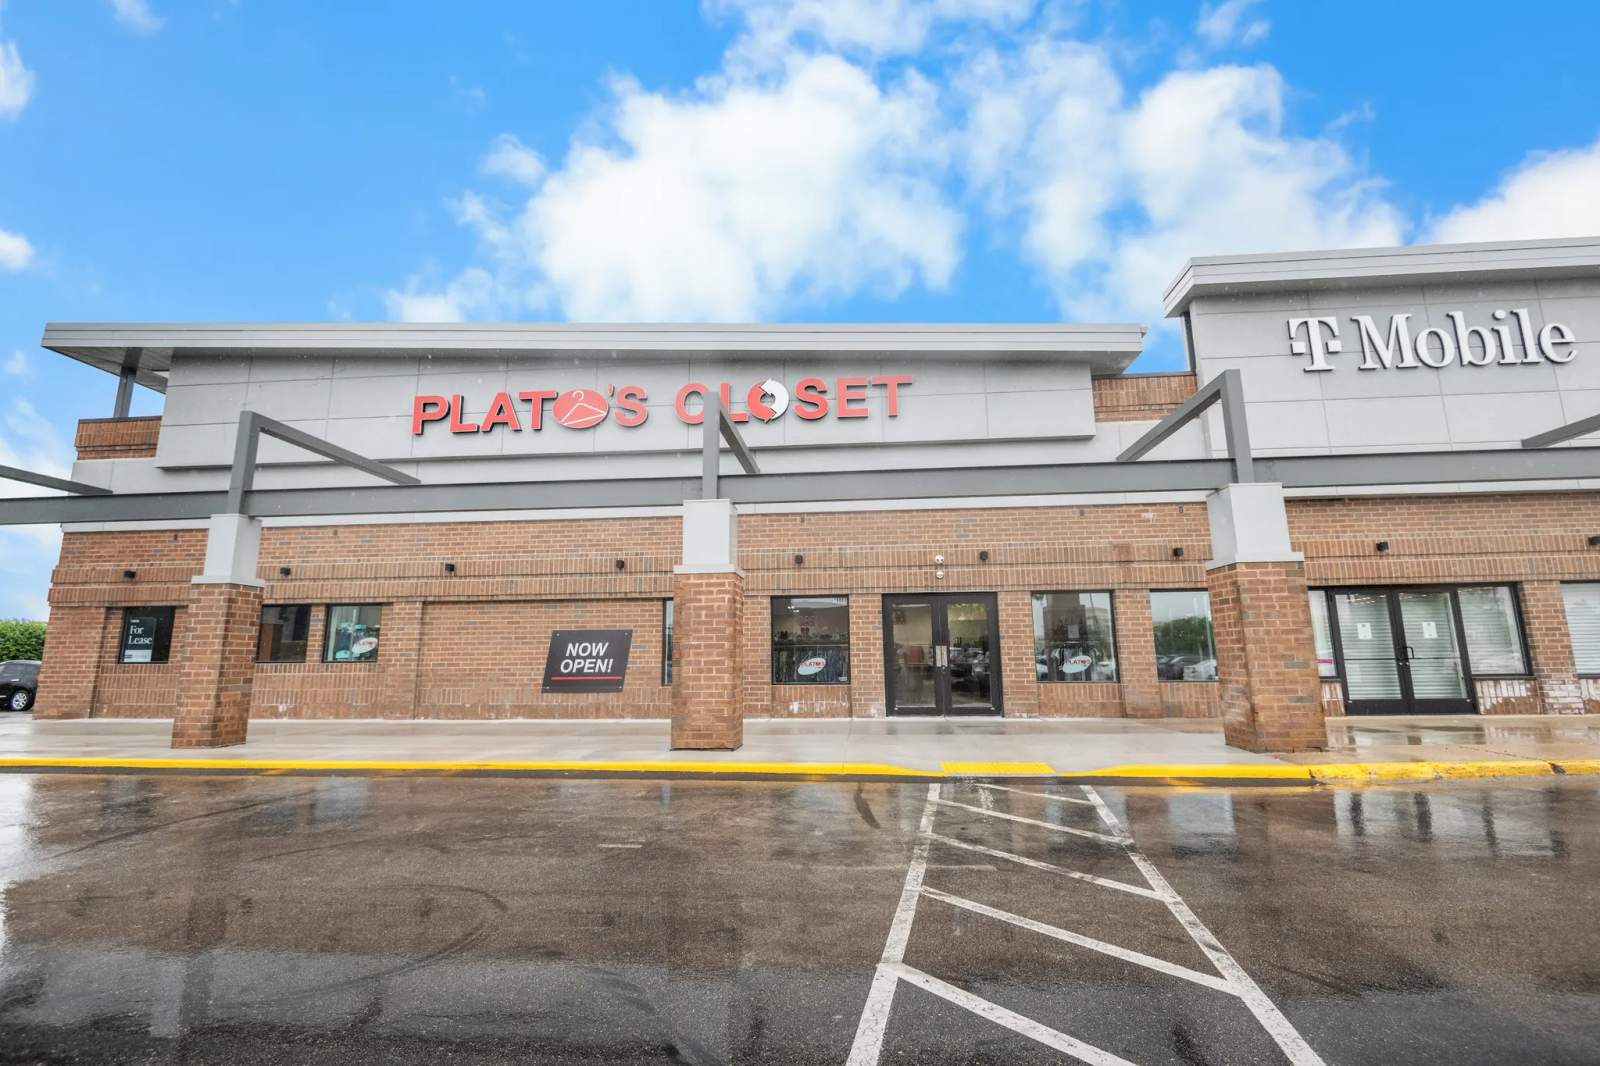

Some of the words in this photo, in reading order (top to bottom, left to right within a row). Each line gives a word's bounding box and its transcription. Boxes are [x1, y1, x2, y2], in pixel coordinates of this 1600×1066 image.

[1350, 308, 1577, 370] Mobile
[412, 384, 648, 435] PLATO'S
[674, 375, 912, 424] CLOSET
[130, 625, 144, 635] For
[128, 635, 153, 645] Lease
[565, 642, 608, 657] NOW
[560, 658, 613, 673] OPEN!
